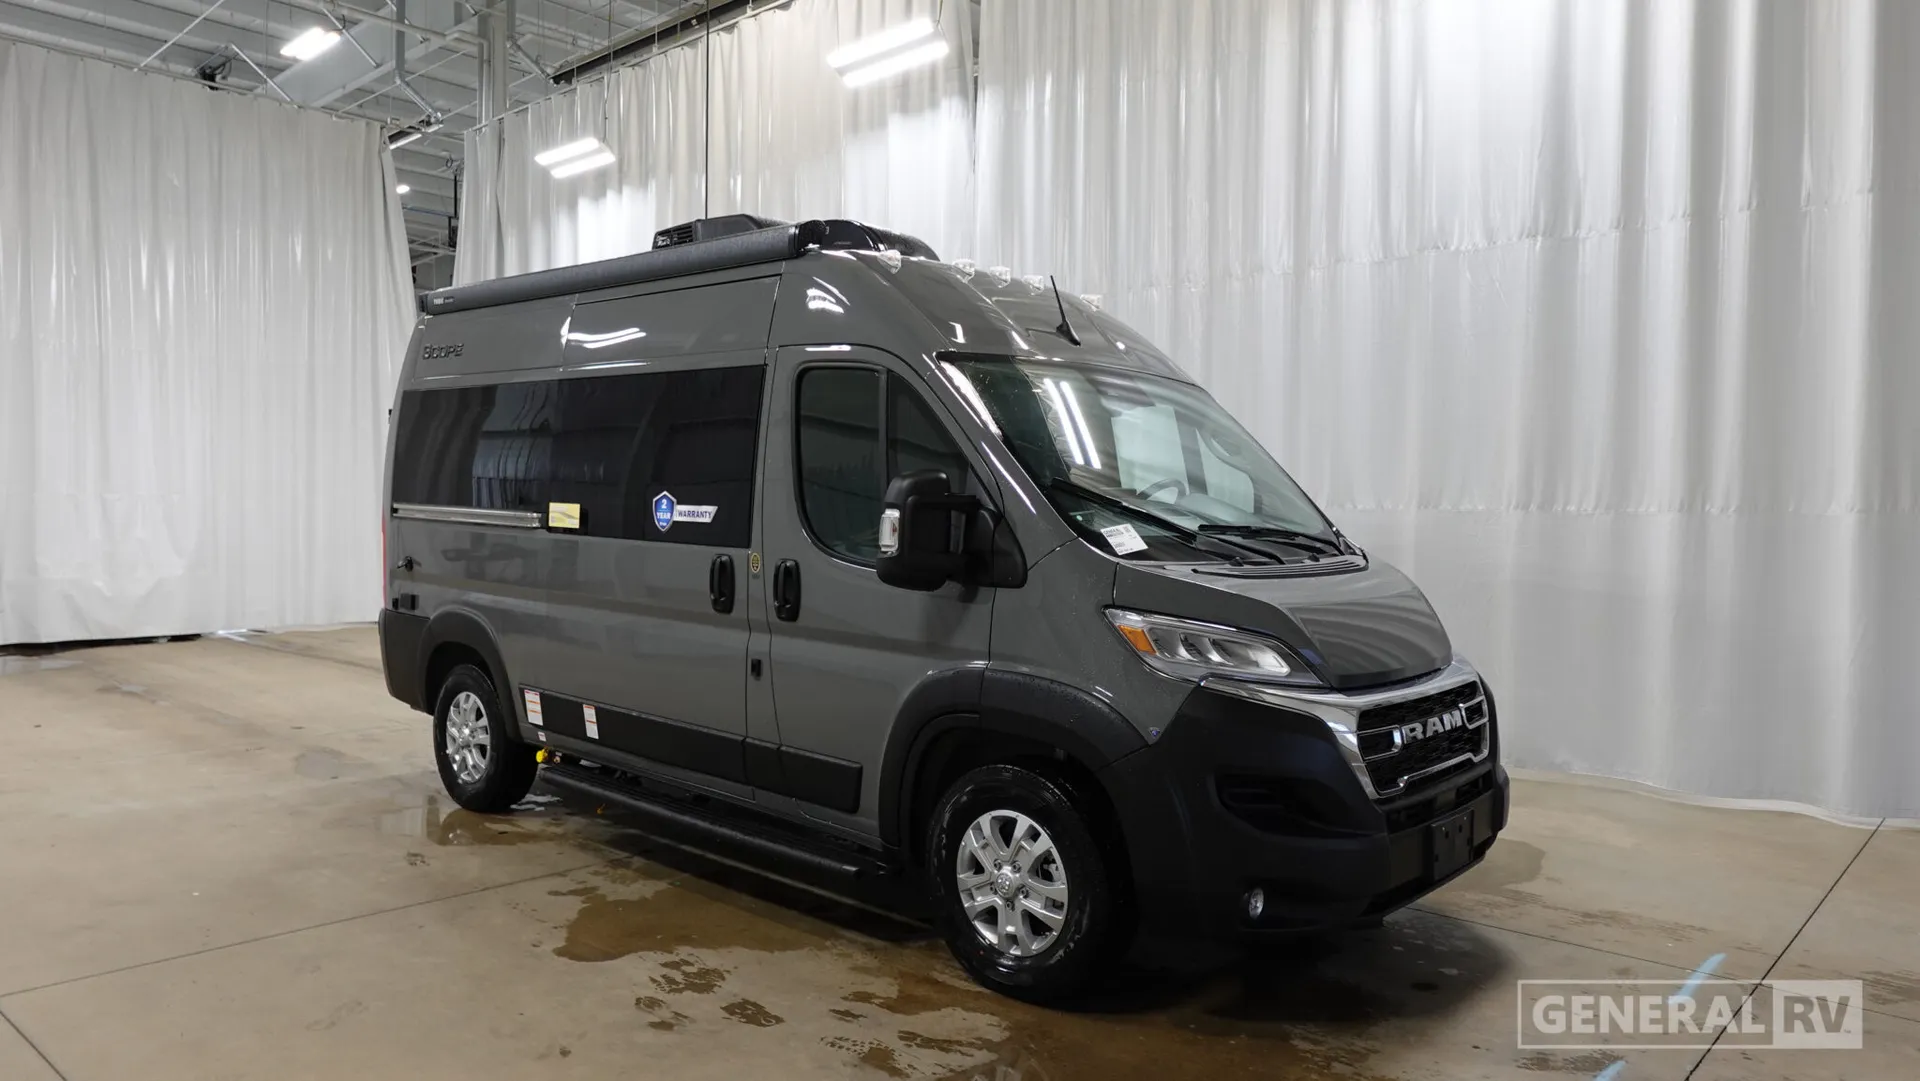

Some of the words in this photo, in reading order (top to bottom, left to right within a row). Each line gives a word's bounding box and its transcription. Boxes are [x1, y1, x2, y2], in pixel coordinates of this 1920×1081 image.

[661, 498, 667, 509] 2
[677, 510, 712, 519] WARRANTY
[1402, 709, 1463, 744] RAM
